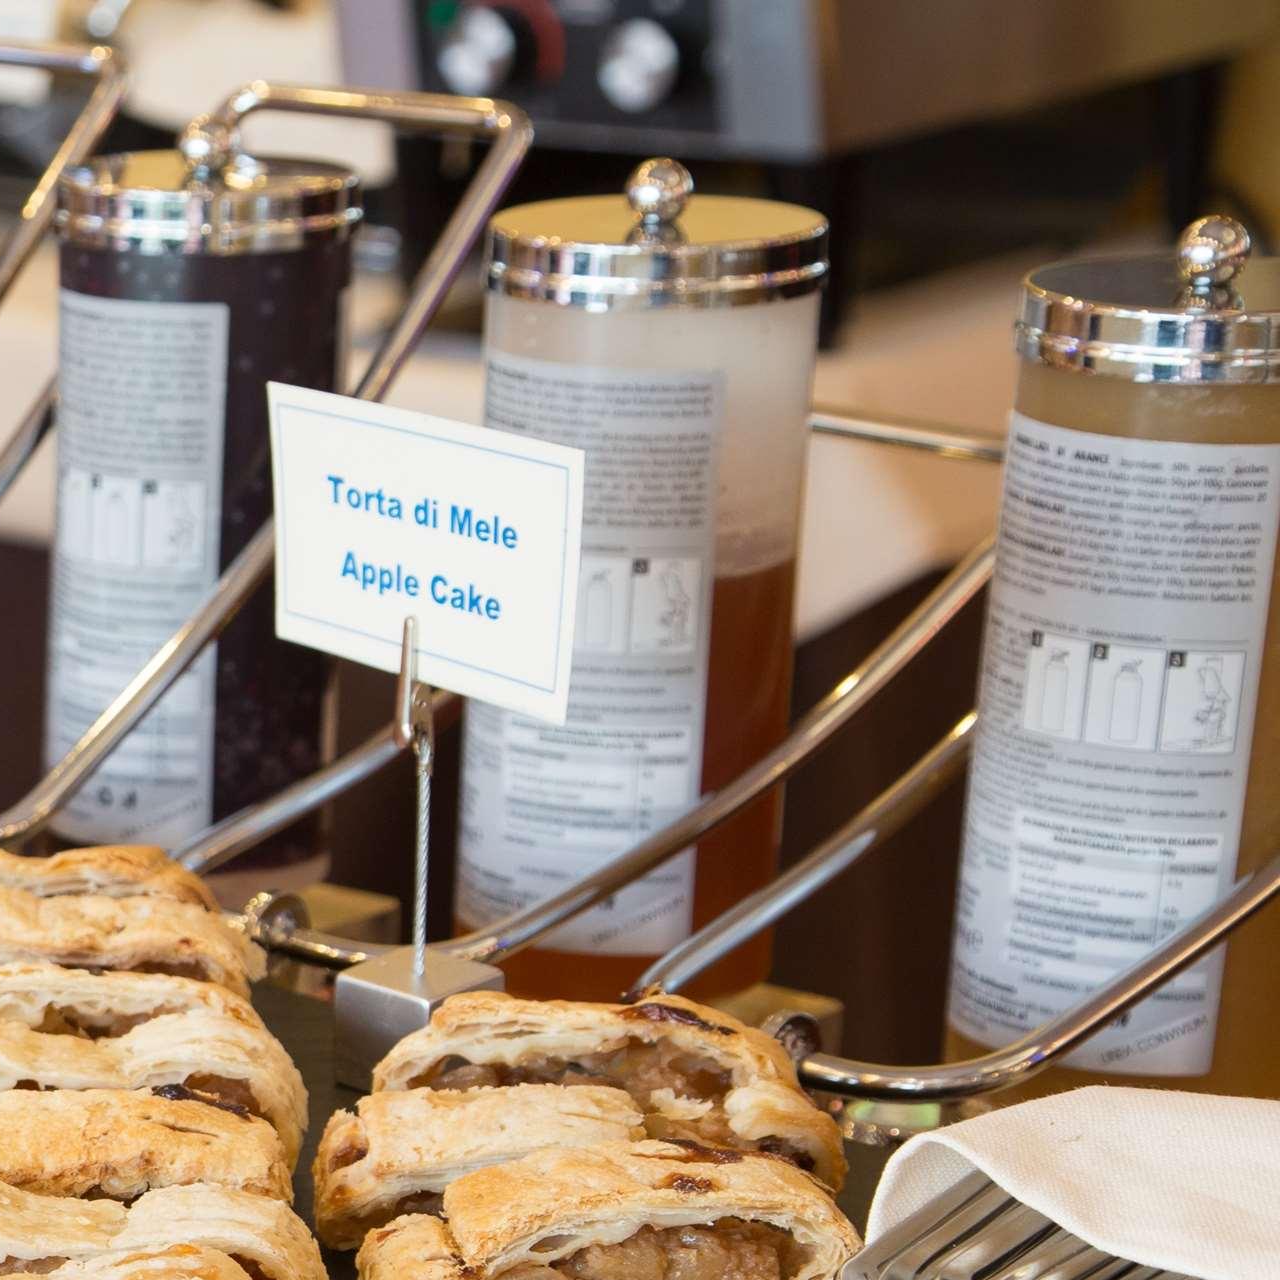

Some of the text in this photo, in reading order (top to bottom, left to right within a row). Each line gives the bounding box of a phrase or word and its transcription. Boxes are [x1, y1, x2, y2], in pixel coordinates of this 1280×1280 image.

[327, 475, 519, 550] Torta di Mele
[341, 551, 503, 621] Apple Cake
